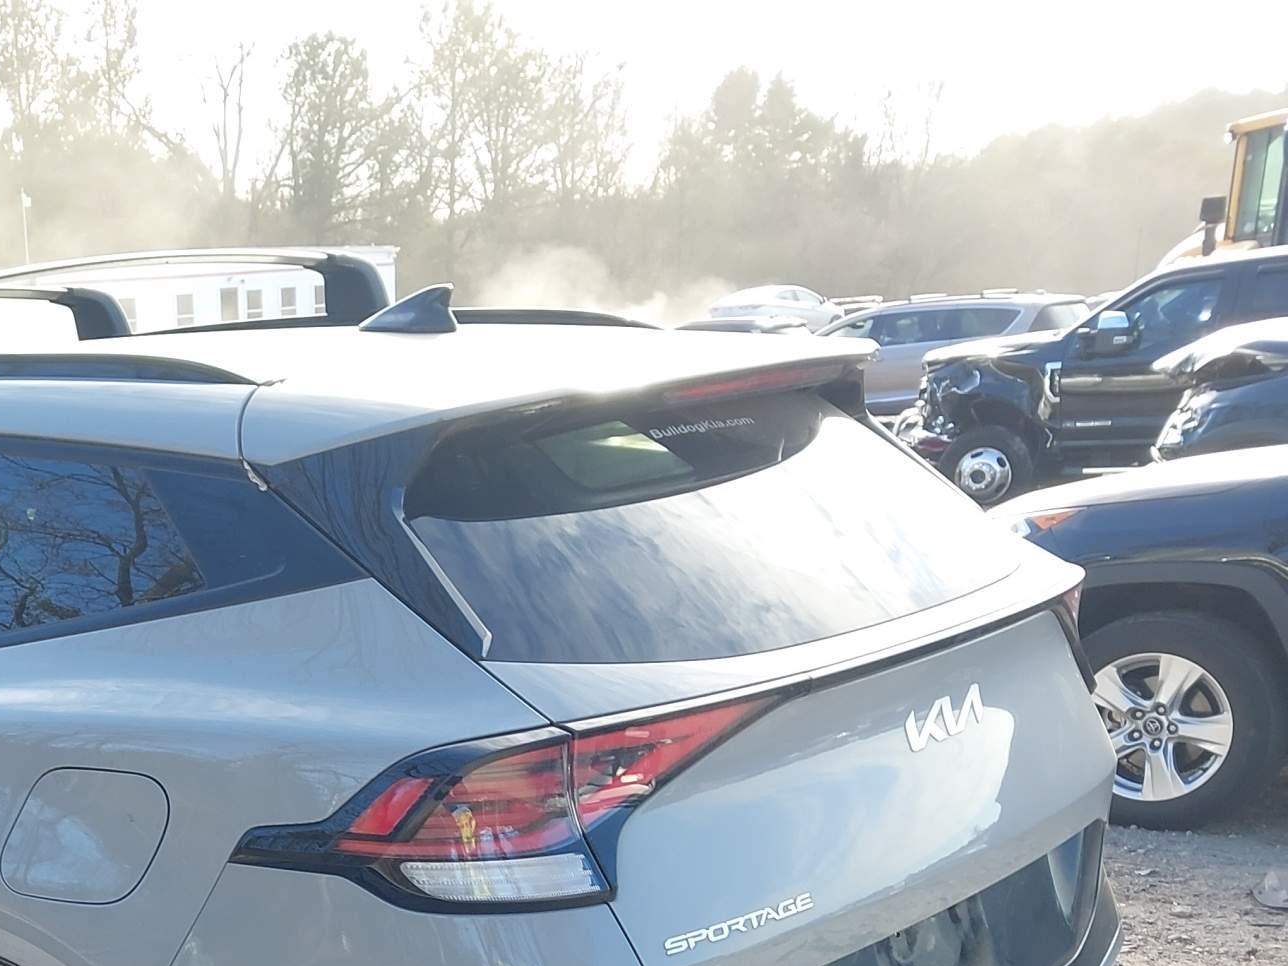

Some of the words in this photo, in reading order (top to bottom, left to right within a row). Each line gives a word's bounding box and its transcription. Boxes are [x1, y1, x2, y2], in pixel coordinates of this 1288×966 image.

[649, 417, 755, 439] BulldogKia.com
[904, 682, 984, 753] KIA
[664, 892, 814, 956] SPORTAGE
